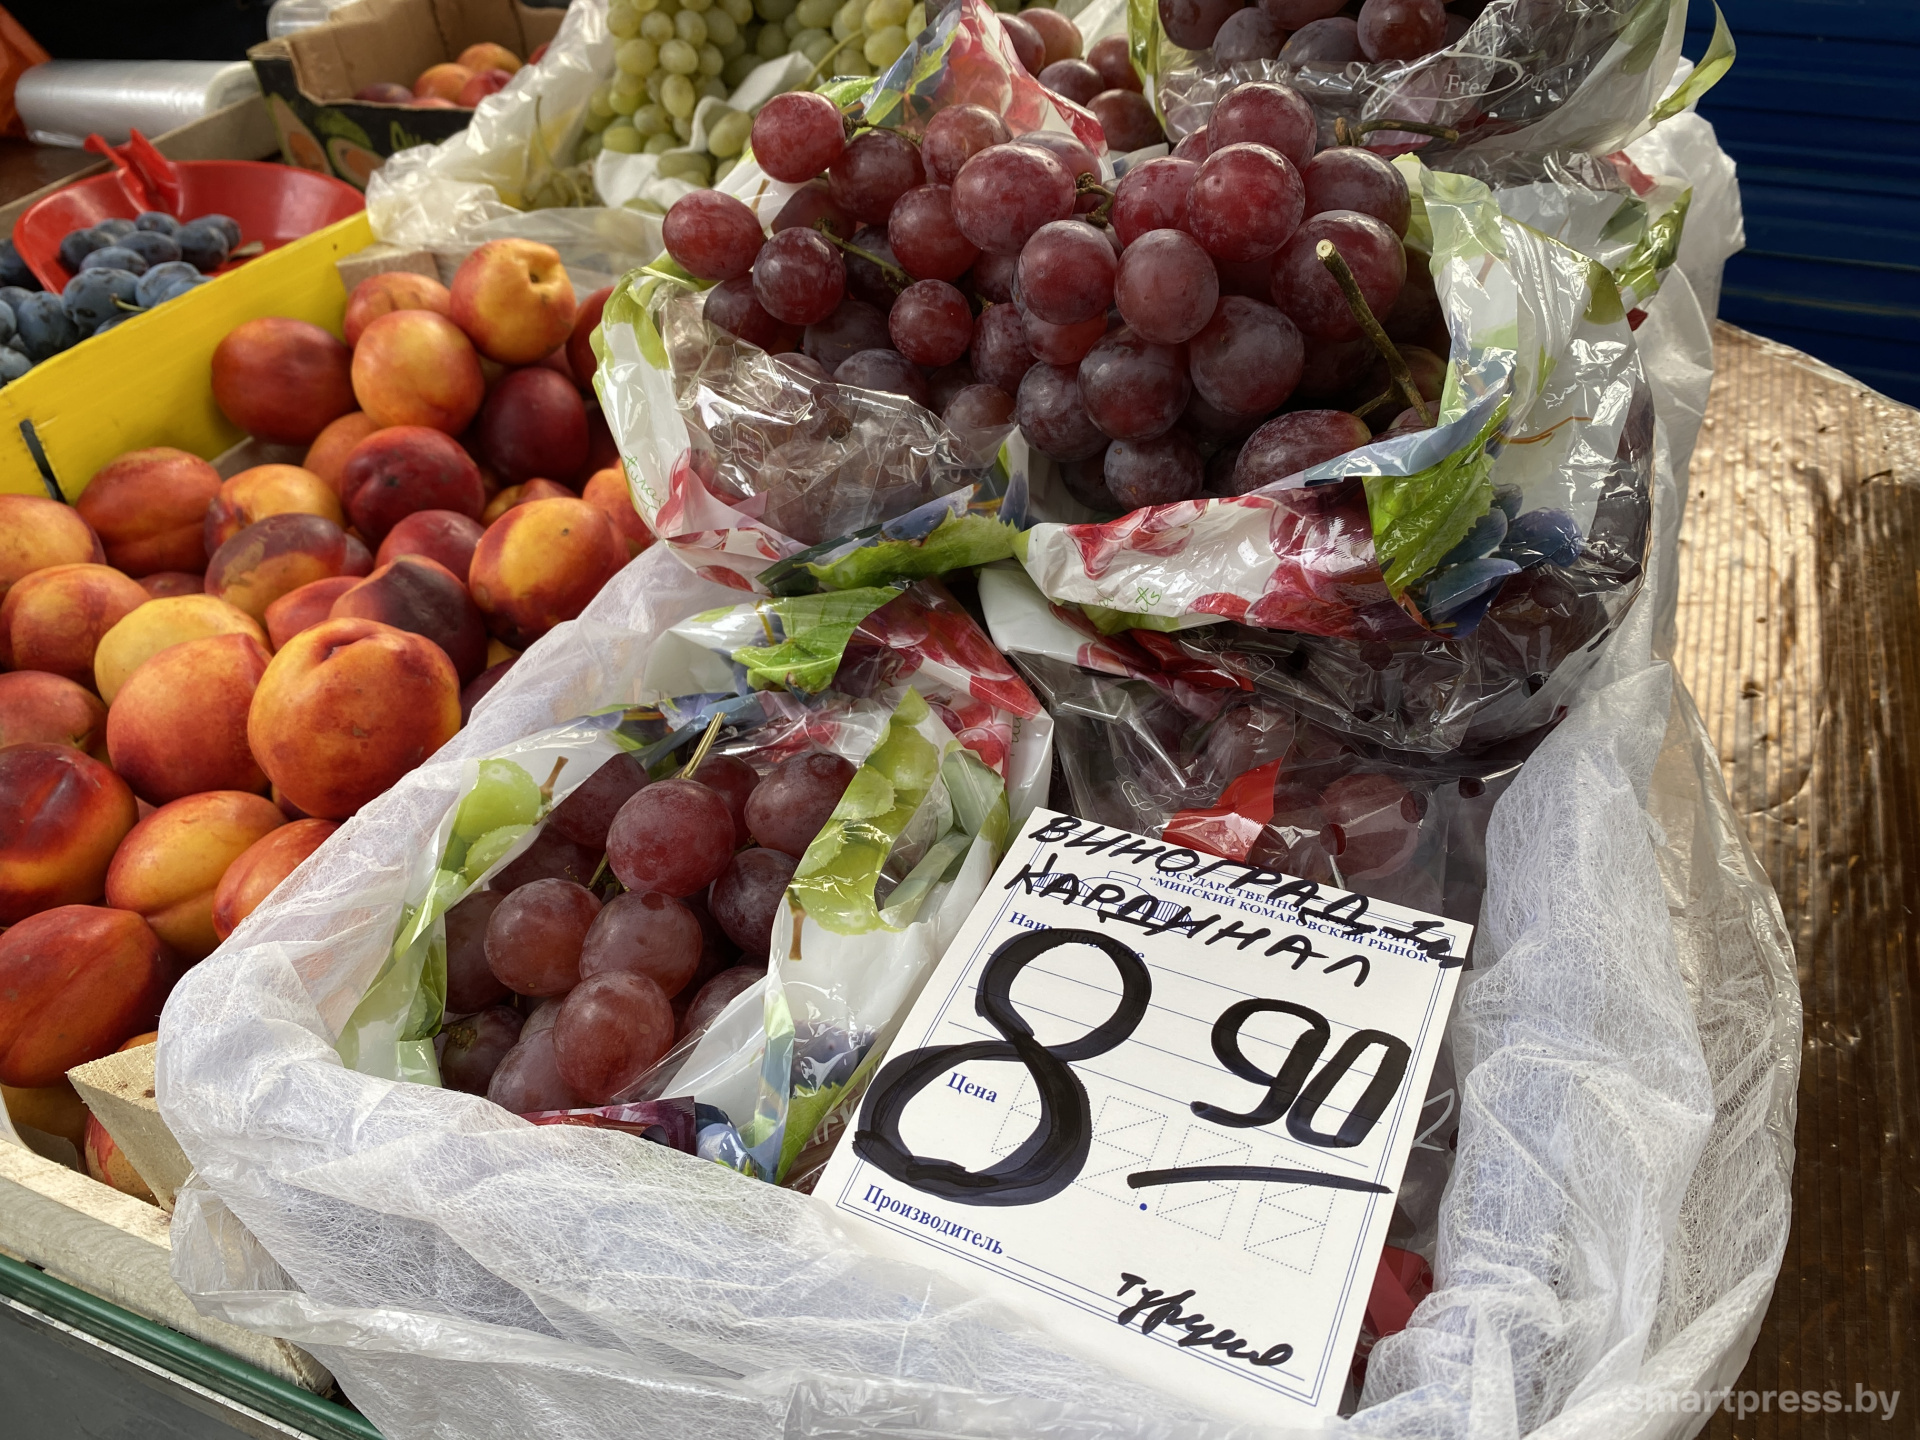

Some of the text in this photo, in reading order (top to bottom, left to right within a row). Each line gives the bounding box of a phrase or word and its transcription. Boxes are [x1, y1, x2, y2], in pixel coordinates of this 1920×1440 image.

[1028, 816, 1377, 935] ВИНОГРАД
[1154, 868, 1310, 915] ГОСУДАРСТВЕННО
[1004, 853, 1371, 988] КАРДИНАЛ
[1238, 899, 1365, 944] КОМАРОВСКИЙ
[852, 928, 1412, 1207] 8 90
[946, 1071, 998, 1103] Цена
[863, 1183, 1004, 1255] Производитель
